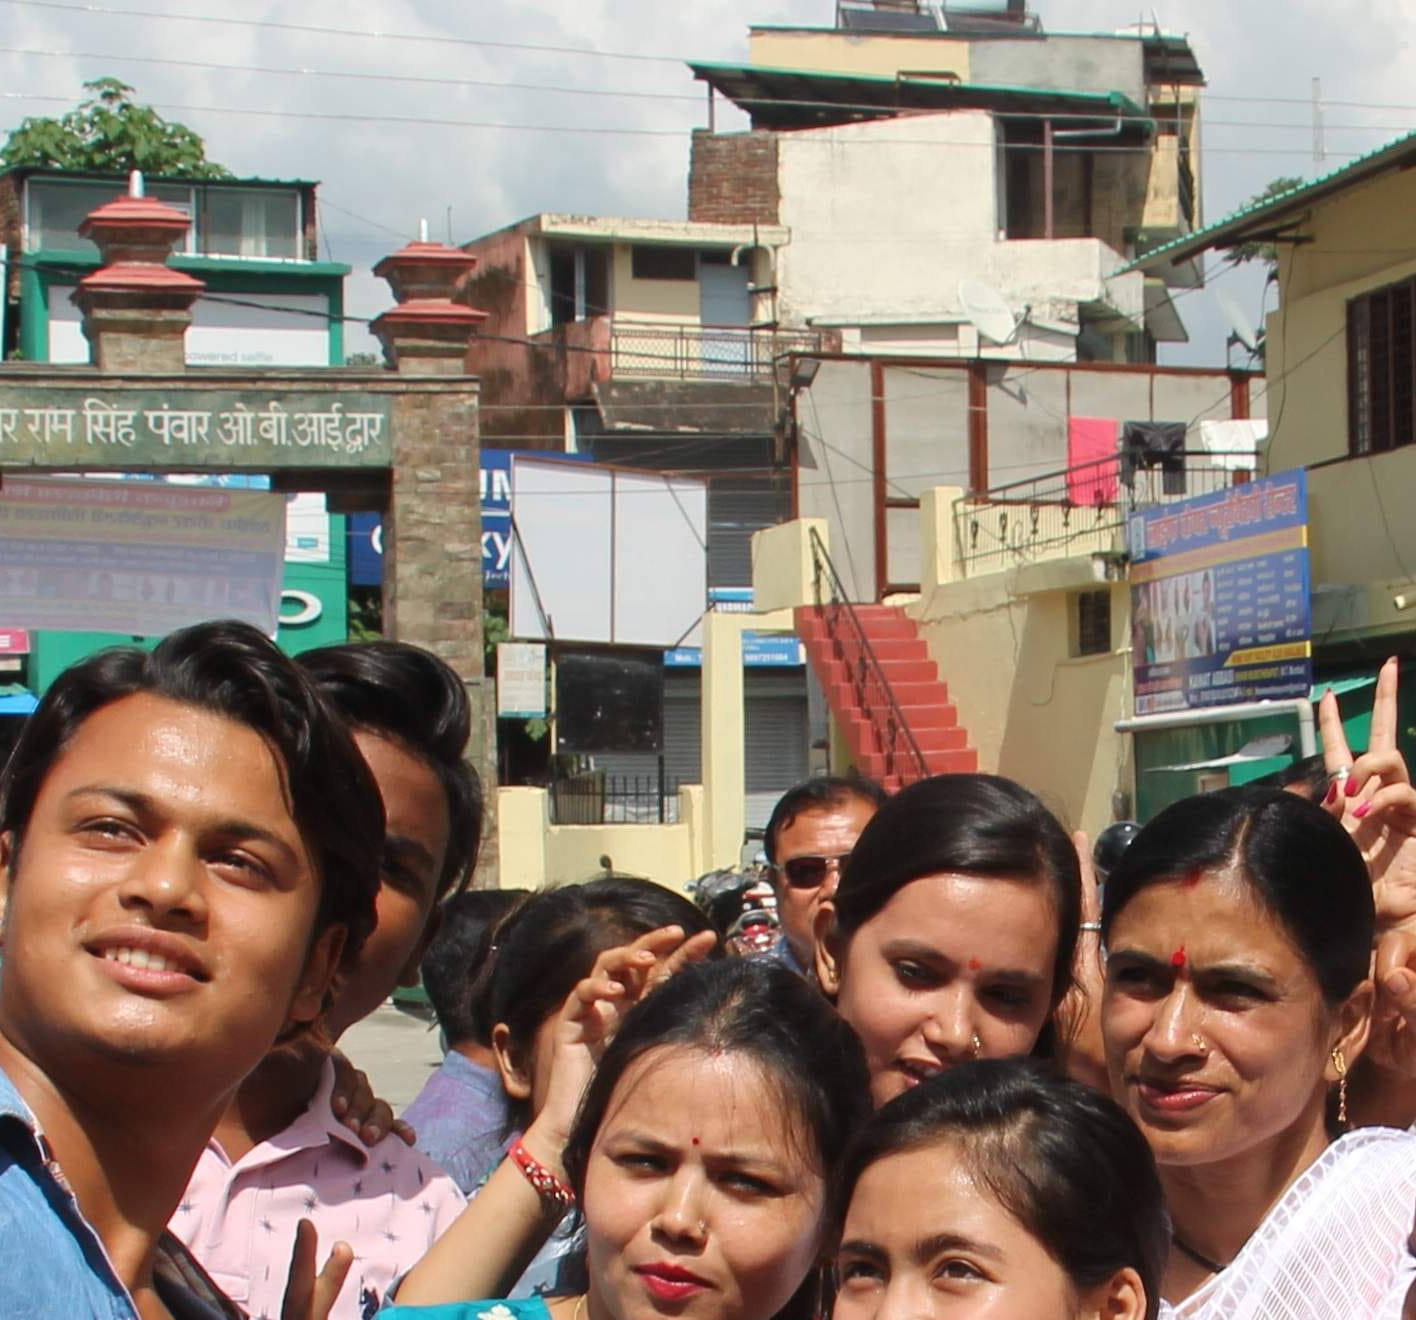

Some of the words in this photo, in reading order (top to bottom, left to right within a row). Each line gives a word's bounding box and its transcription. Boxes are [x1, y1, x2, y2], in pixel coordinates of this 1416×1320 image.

[24, 408, 77, 444] राम
[82, 397, 138, 447] सिंह
[144, 403, 212, 445] पंवार
